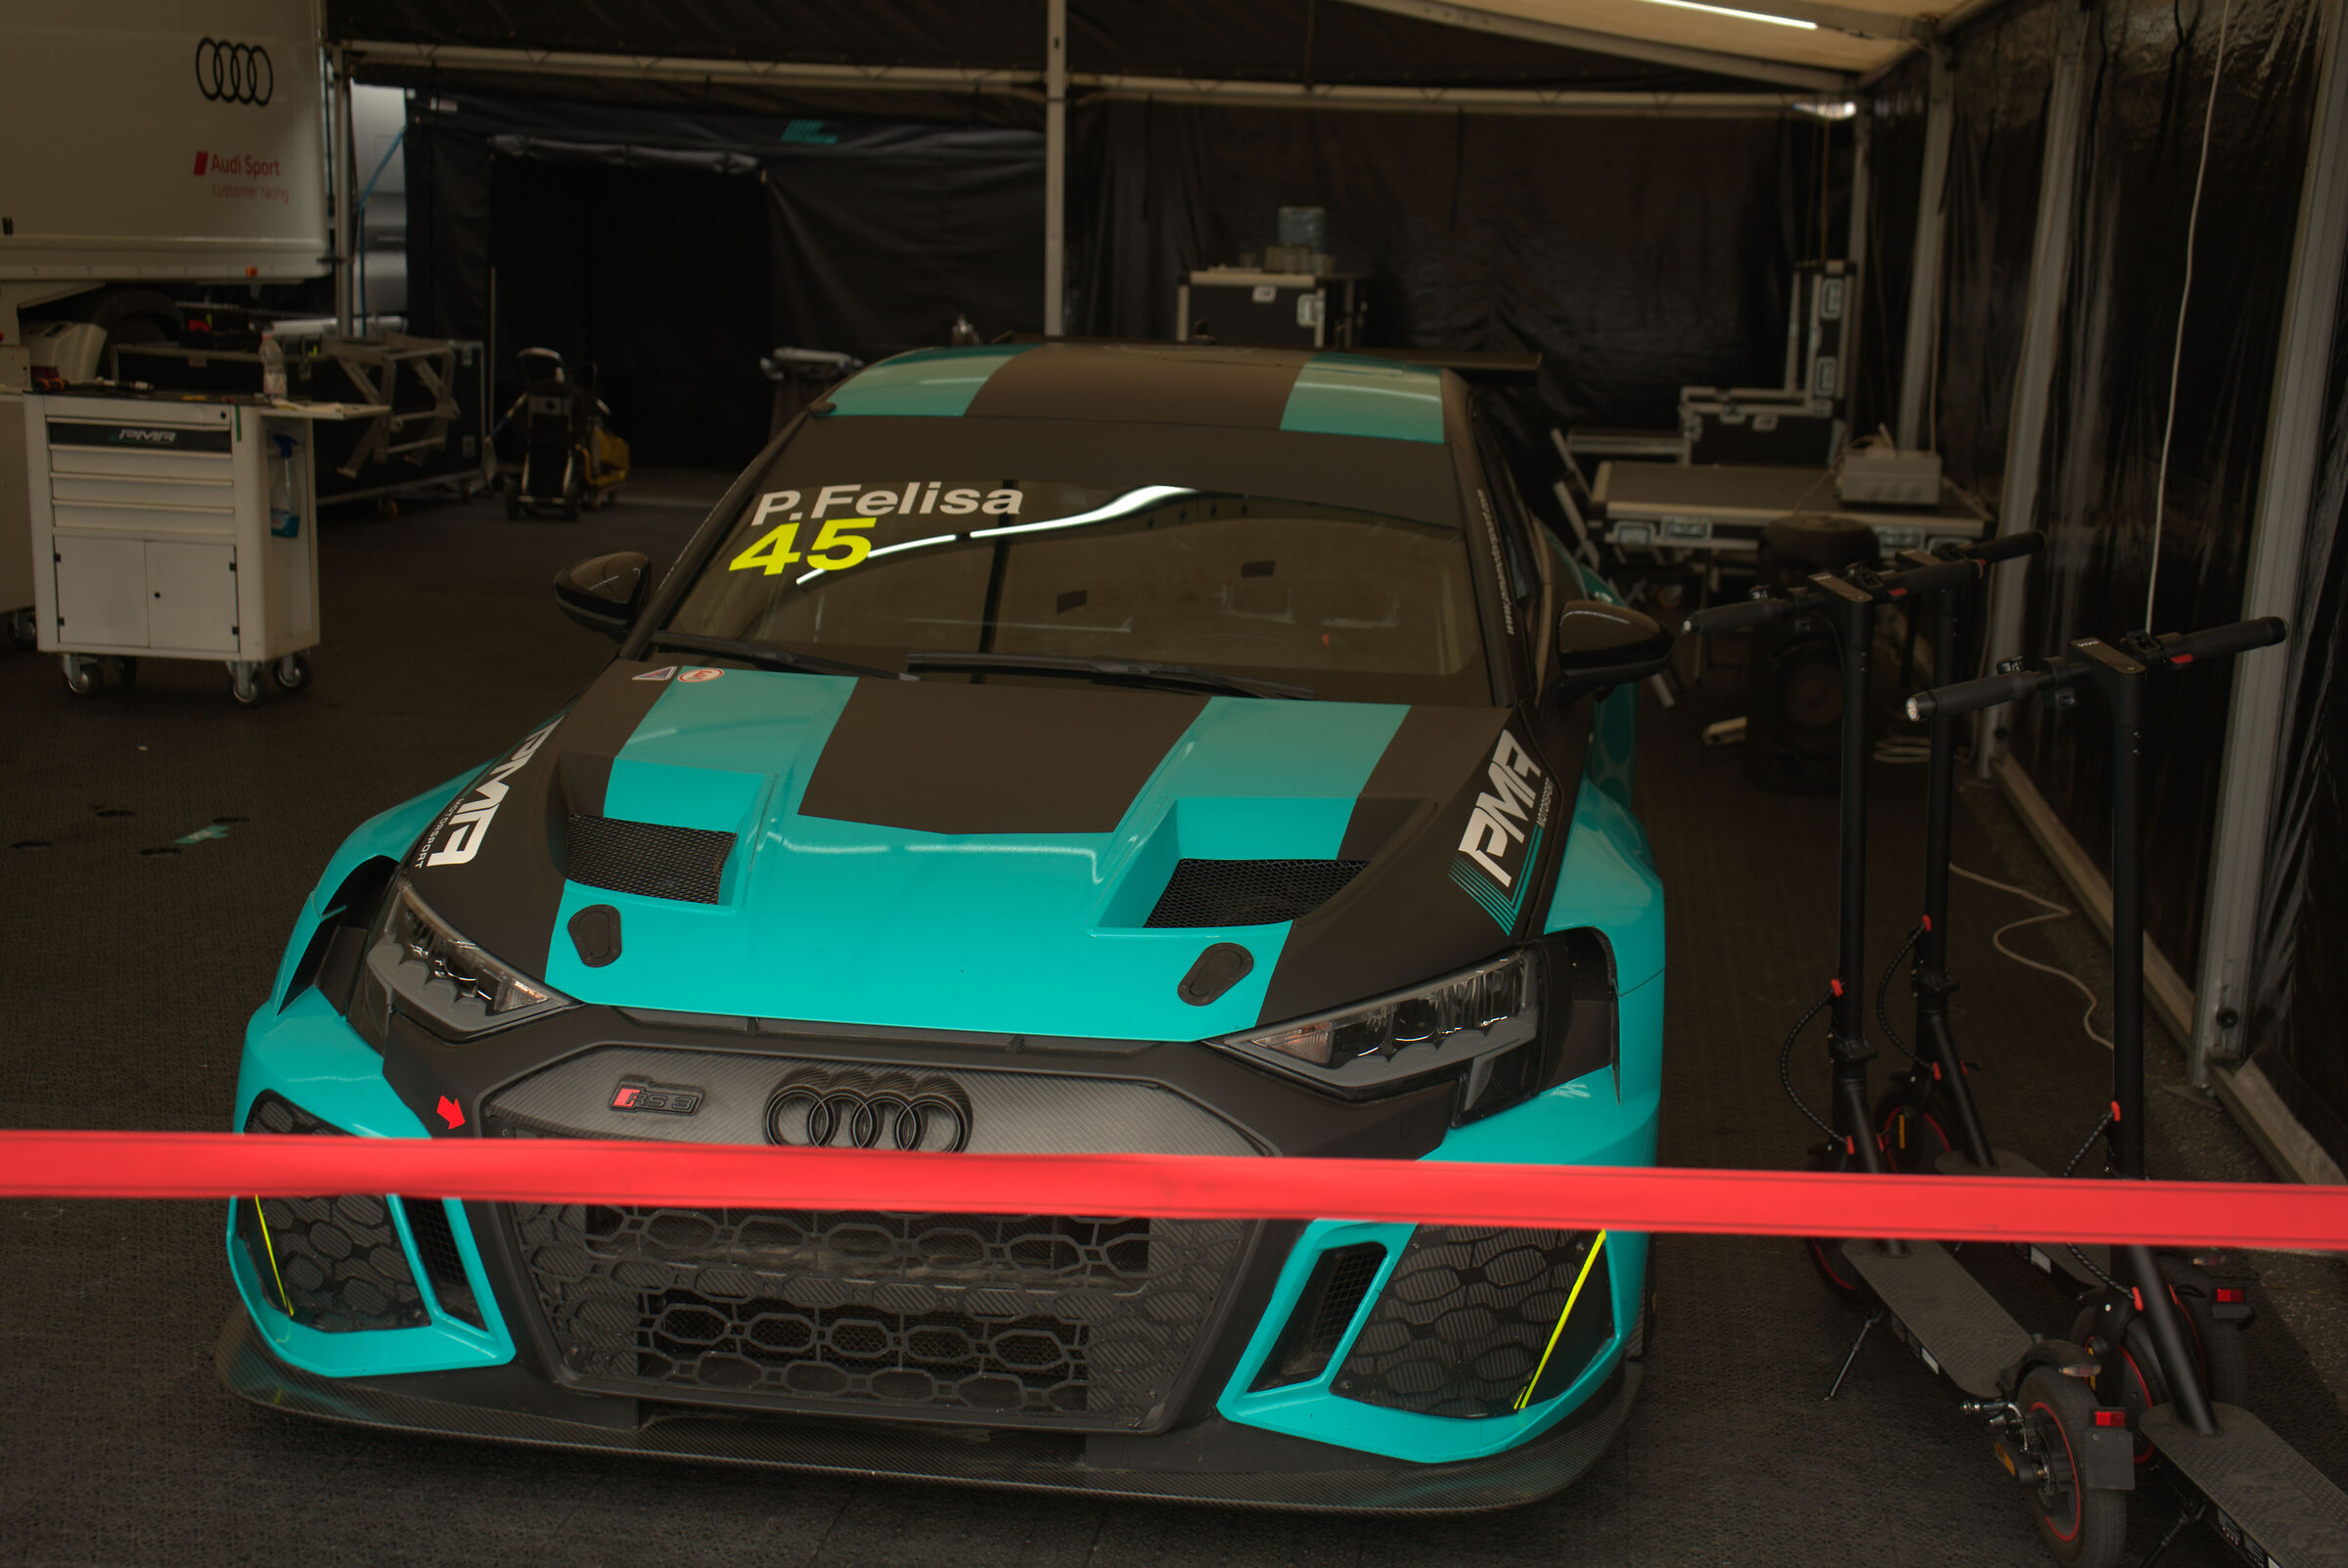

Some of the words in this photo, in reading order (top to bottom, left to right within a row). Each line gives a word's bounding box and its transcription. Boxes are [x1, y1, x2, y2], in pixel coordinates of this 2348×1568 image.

[211, 153, 242, 174] Audi
[244, 155, 281, 178] Sport
[750, 481, 1024, 526] P.Felisa
[728, 516, 878, 576] 45
[1536, 776, 1555, 829] MOTORSPORT
[414, 797, 465, 869] MOTORSPORT
